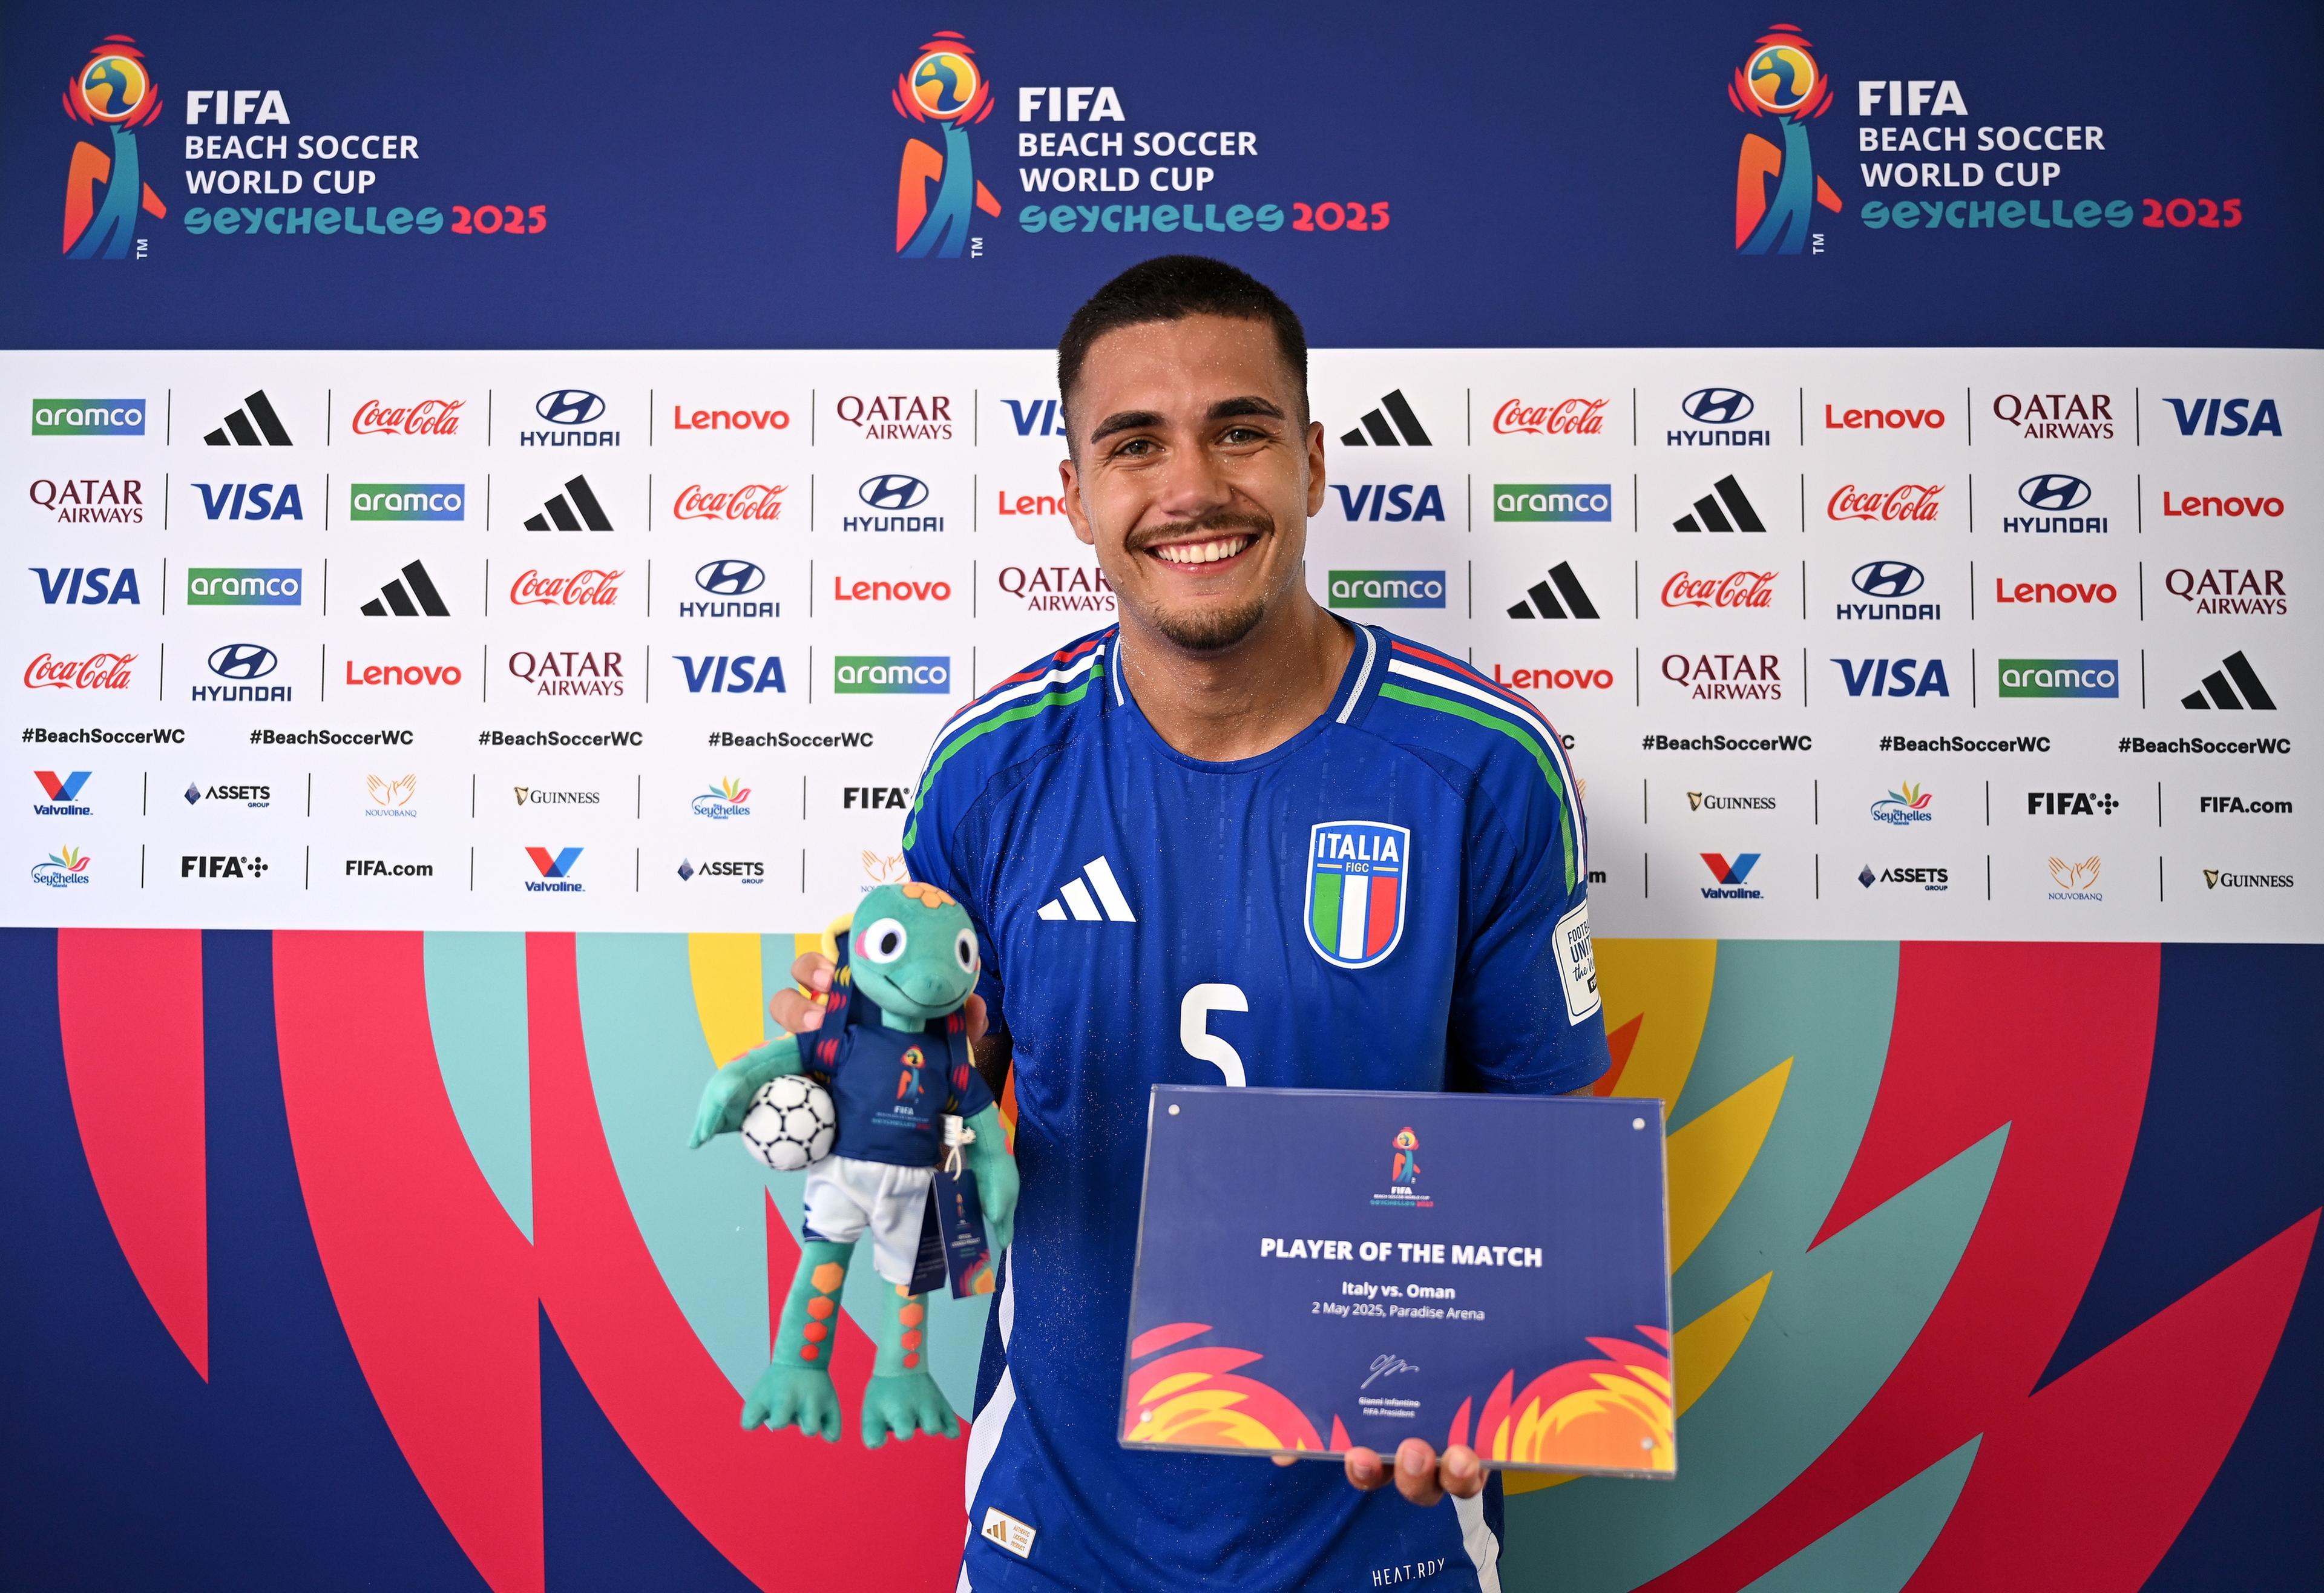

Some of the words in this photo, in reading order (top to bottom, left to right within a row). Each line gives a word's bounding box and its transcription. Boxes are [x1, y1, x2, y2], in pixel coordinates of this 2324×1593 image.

[187, 90, 290, 124] FIFA
[1019, 87, 1125, 122] FIFA
[1859, 80, 1968, 116] FIFA
[186, 136, 286, 159] BEACH
[298, 136, 419, 159] SOCCER
[1019, 133, 1122, 156] BEACH
[1134, 132, 1258, 156] SOCCER
[1860, 127, 1965, 151] BEACH
[1978, 126, 2105, 151] SOCCER
[186, 171, 302, 194] WORLD
[313, 171, 375, 194] CUP
[1019, 168, 1139, 192] WORLD
[1151, 167, 1213, 191] CUP
[1861, 163, 1983, 187] WORLD
[1995, 163, 2060, 186] CUP
[451, 205, 547, 234] 2025
[1293, 202, 1390, 231] 2025
[2143, 199, 2242, 228] 2025
[36, 409, 142, 425] aramco
[352, 400, 465, 435] Coca-Cola
[675, 406, 789, 429] Lenovo
[837, 396, 951, 427] QATAR
[1000, 398, 1068, 436] VI
[1493, 399, 1609, 434] Coca-Cola
[1826, 404, 1945, 429] Lenovo
[1994, 395, 2112, 426] QATAR
[2162, 398, 2282, 436] VISA
[521, 432, 620, 446] HYUNDAI
[866, 425, 951, 439] AIRWAYS
[1667, 431, 1770, 445] HYUNDAI
[2024, 424, 2113, 439] AIRWAYS
[30, 480, 142, 510] QATAR
[191, 484, 303, 520] VISA
[355, 494, 461, 511] aramco
[674, 485, 787, 520] Coca-Cola
[999, 491, 1067, 515] Len
[1329, 484, 1445, 522] VISA
[1497, 494, 1607, 511] aramco
[1828, 485, 1945, 521] Coca-Cola
[2164, 491, 2284, 517] Lenovo
[58, 508, 142, 523] AIRWAYS
[844, 517, 944, 531] HYUNDAI
[2004, 517, 2107, 533] HYUNDAI
[28, 568, 140, 605] VISA
[191, 578, 298, 596] aramco
[510, 570, 625, 605] Coca-Cola
[835, 577, 951, 600] Lenovo
[1332, 581, 1442, 598] aramco
[1661, 571, 1778, 607] Coca-Cola
[1997, 578, 2116, 603] Lenovo
[2166, 569, 2286, 601] QATAR
[680, 602, 780, 617] HYUNDAI
[1028, 596, 1115, 611] AIRWAYS
[1837, 605, 1940, 620] HYUNDAI
[2197, 599, 2286, 614] AIRWAYS
[24, 653, 137, 689] Coca-Cola
[347, 661, 461, 685] Lenovo
[509, 652, 623, 683] QATAR
[672, 656, 786, 693] VISA
[838, 666, 947, 684] aramco
[1494, 664, 1613, 689] Lenovo
[1662, 655, 1780, 687] QATAR
[1830, 659, 1949, 697] VISA
[2003, 669, 2115, 688] aramco
[192, 686, 291, 701] HYUNDAI
[538, 681, 623, 695] AIRWAYS
[1693, 684, 1781, 700] AIRWAYS
[22, 728, 185, 743] #BeachSoccerWC
[250, 730, 413, 744] #BeachSoccerWC
[479, 731, 642, 746] #BeachSoccerWC
[709, 732, 873, 747] #BeachSoccerWC
[1643, 735, 1811, 751] #BeachSoccerWC
[1880, 737, 2050, 752] #BeachSoccerWC
[2118, 738, 2290, 754] #BeachSoccerWC
[531, 790, 599, 803] GUINNESS
[1704, 795, 1776, 809] GUINNESS
[2201, 797, 2292, 813] FIFA.com
[694, 805, 750, 817] Seychelles
[1874, 810, 1931, 823] Seychelles
[1318, 833, 1399, 864] ITALIA
[346, 861, 433, 876] FIFA.com
[1346, 862, 1368, 872] FIGC
[34, 873, 89, 885] Seychelles
[2221, 873, 2294, 887] GUINNESS
[2049, 893, 2102, 901] NOUVOBANQ
[1567, 919, 1589, 945] FOOTB
[1570, 935, 1592, 964] UNIT
[1391, 1186, 1413, 1195] FIFA
[1261, 1238, 1353, 1260] PLAYER
[1360, 1242, 1392, 1261] OF
[1398, 1243, 1445, 1263] THE
[1452, 1245, 1541, 1267] MATCH
[1342, 1282, 1377, 1299] Italy
[1382, 1286, 1402, 1296] vs.
[1407, 1284, 1455, 1299] Oman
[1312, 1302, 1320, 1313] 2
[1324, 1302, 1350, 1317] May
[1353, 1304, 1386, 1316] 2025,
[1390, 1305, 1444, 1318] Paradise
[1446, 1307, 1485, 1320] Arena
[1358, 1396, 1383, 1405] Gianni
[1362, 1407, 1379, 1415] FIFA
[1380, 1408, 1415, 1417] President
[1373, 1558, 1445, 1587] HEAT.RDY
